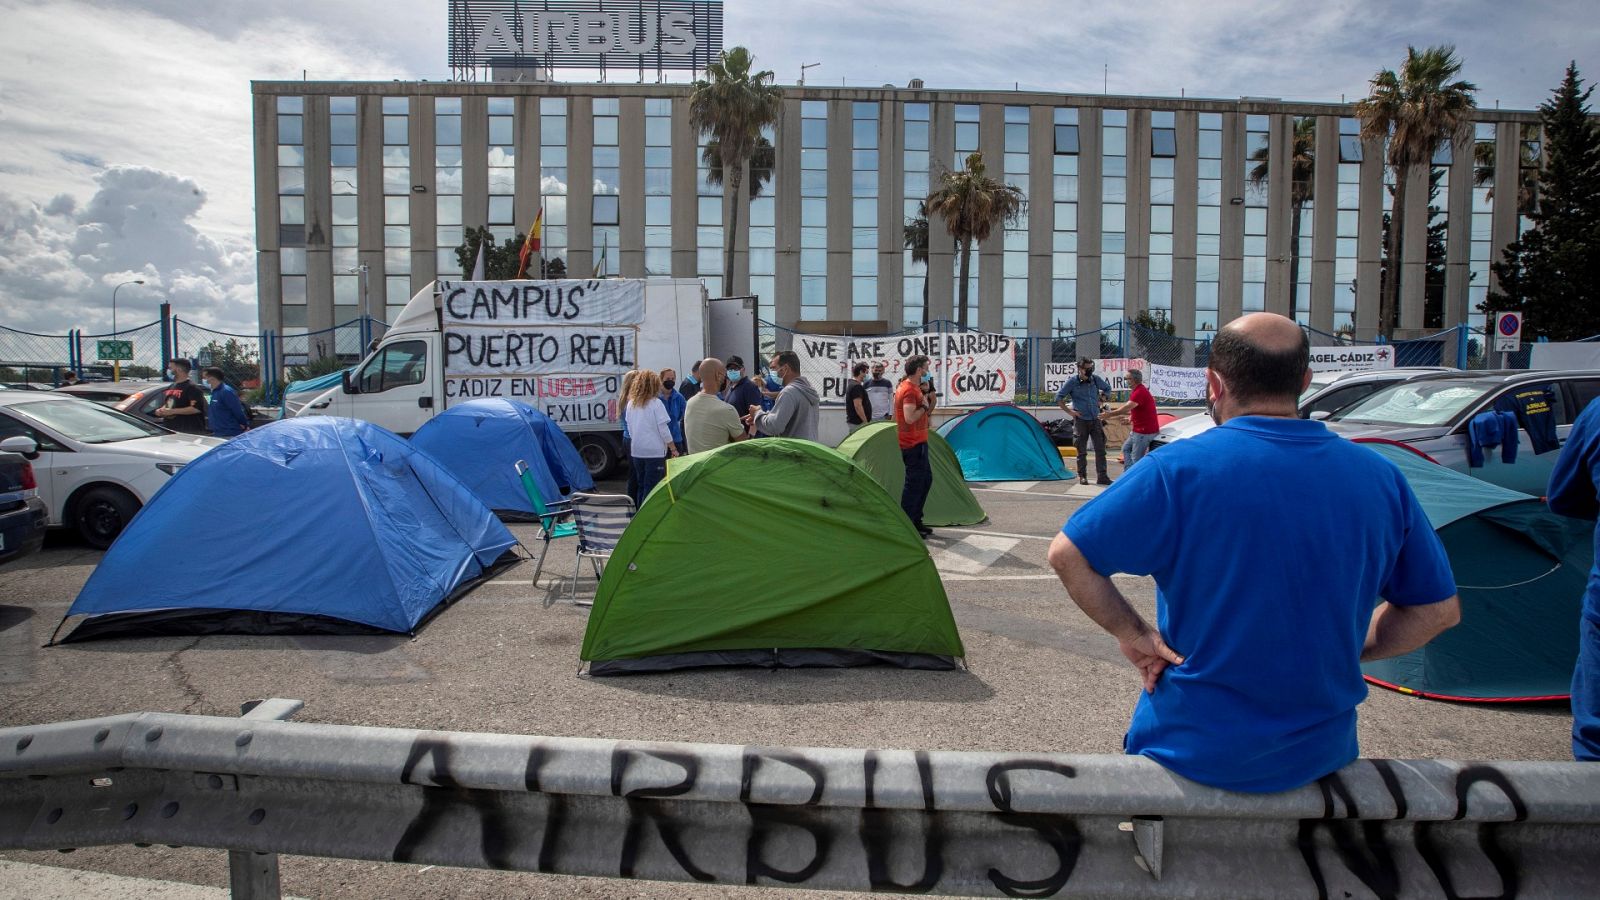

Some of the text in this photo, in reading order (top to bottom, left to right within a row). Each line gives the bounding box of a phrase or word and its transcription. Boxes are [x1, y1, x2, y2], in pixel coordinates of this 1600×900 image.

[472, 10, 696, 54] AIRBUS
[441, 280, 600, 320] "CAMPUS"
[444, 332, 634, 368] PUERTO REAL
[802, 333, 1010, 360] WE ARE ONE AIRBUS
[1046, 364, 1078, 375] NUES
[445, 376, 618, 398] CÁDIZ EN LUCHA O
[823, 377, 847, 397] PU
[1046, 380, 1067, 392] EST
[392, 738, 1530, 900] AIRBUS NO
